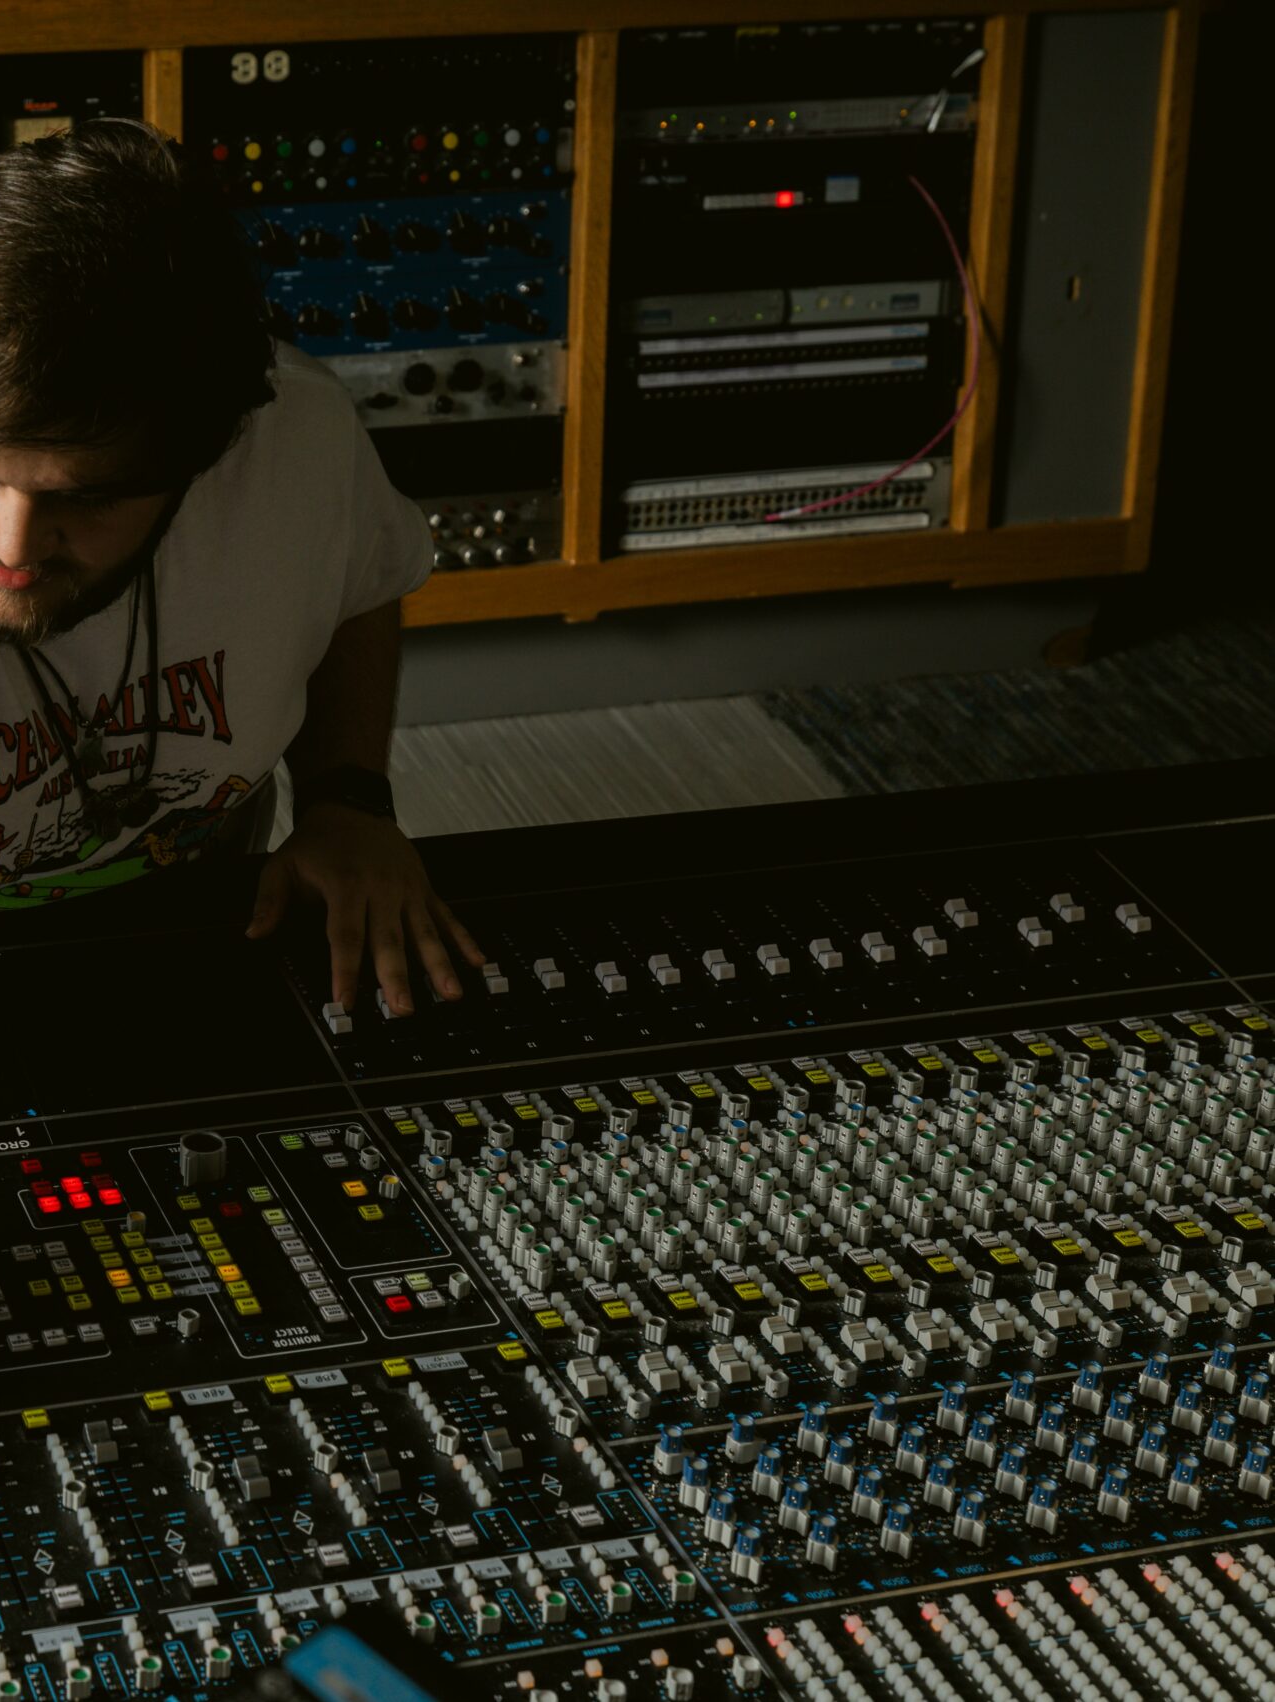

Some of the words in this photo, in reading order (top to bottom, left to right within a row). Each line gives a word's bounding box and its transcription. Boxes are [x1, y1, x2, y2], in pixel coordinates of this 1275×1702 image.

[92, 650, 233, 745] ALLEY
[37, 744, 148, 808] AUSLIA
[15, 1126, 25, 1136] 1
[275, 1326, 309, 1338] SELECT
[273, 1334, 321, 1348] MONITOR
[300, 1378, 309, 1386] A
[315, 1374, 338, 1385] 480
[187, 1393, 196, 1401] B
[203, 1388, 226, 1398] 480
[152, 1486, 168, 1495] R4
[25, 1505, 40, 1514] R5
